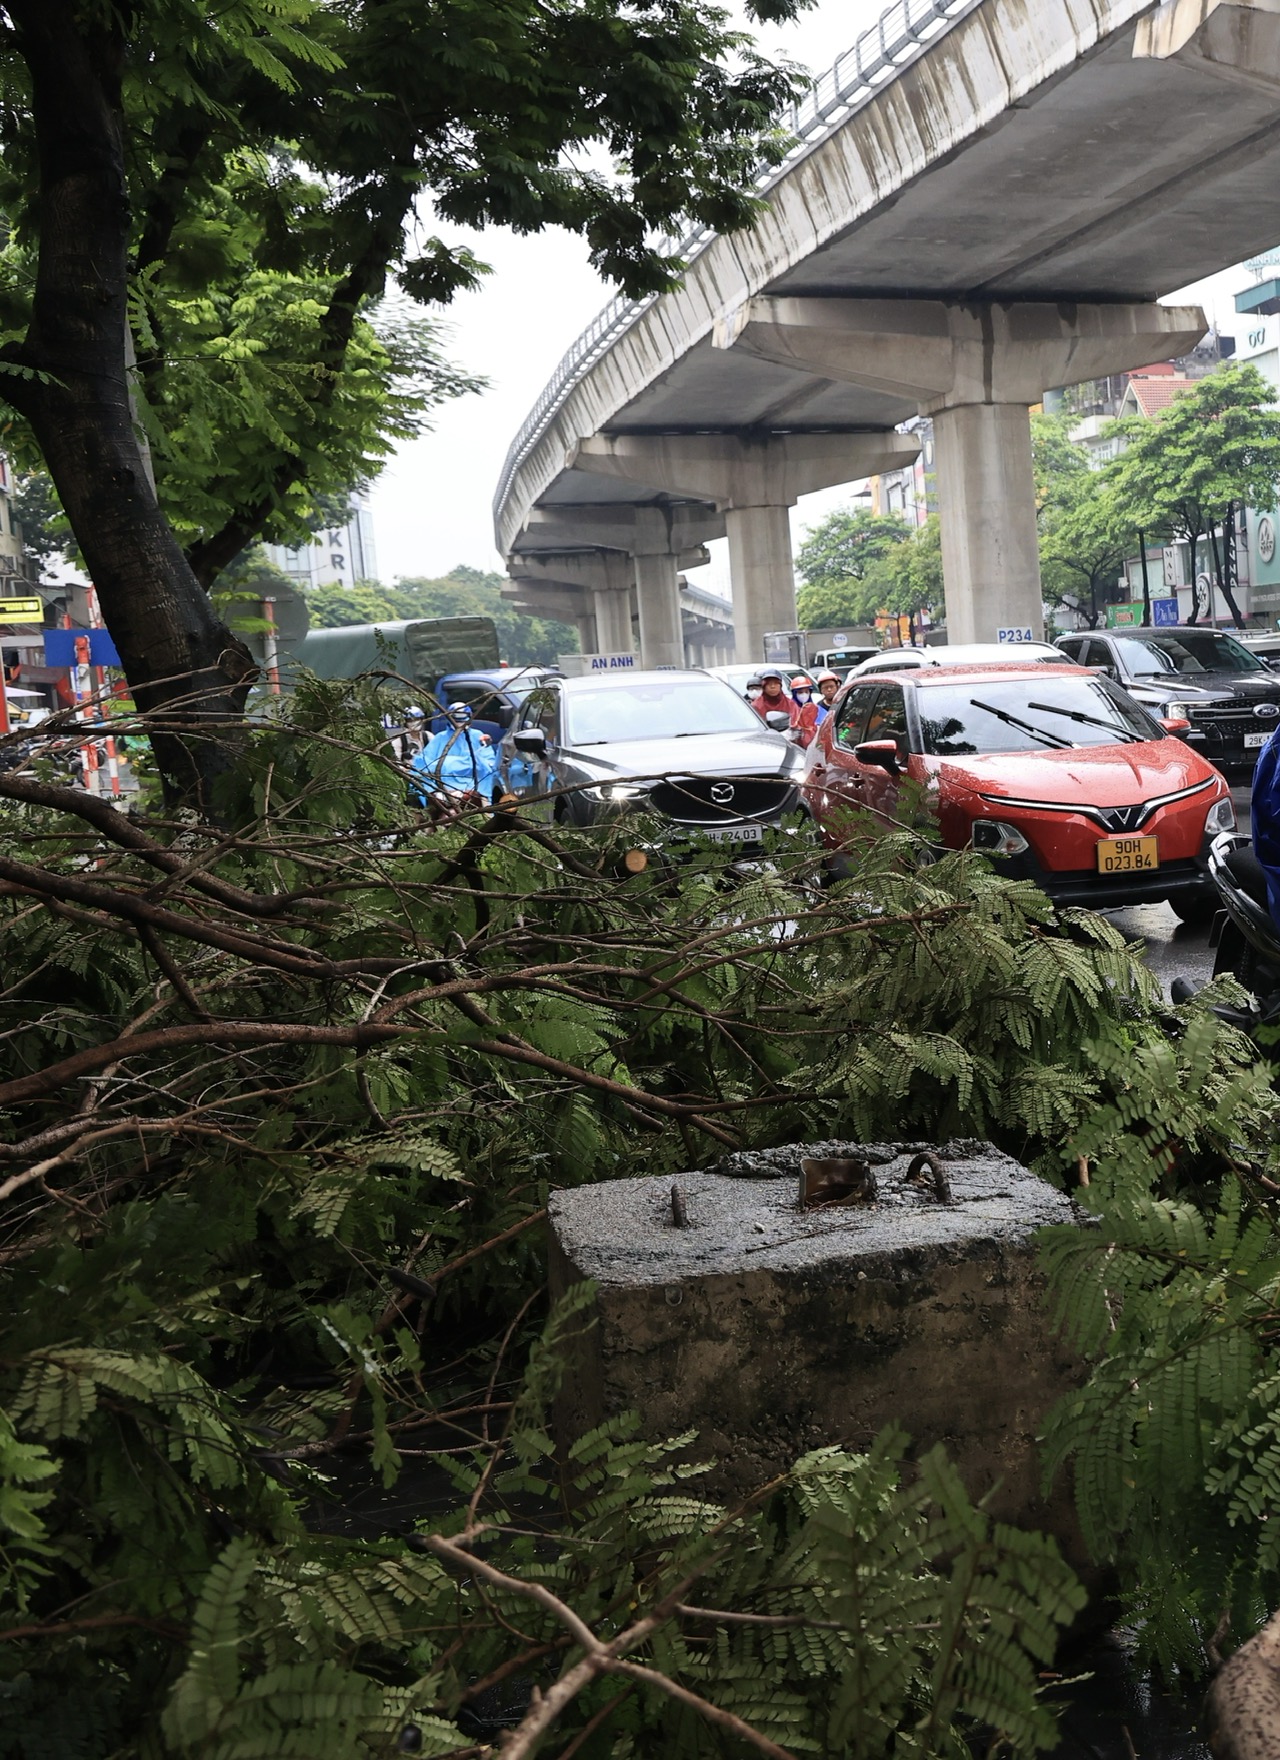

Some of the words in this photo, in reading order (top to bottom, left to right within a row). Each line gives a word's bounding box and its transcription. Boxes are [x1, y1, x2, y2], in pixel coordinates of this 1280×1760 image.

[998, 629, 1032, 643] P234
[592, 658, 607, 669] AN
[610, 656, 634, 668] ANH
[1115, 839, 1142, 854] 90H
[1104, 854, 1153, 871] 023.84
